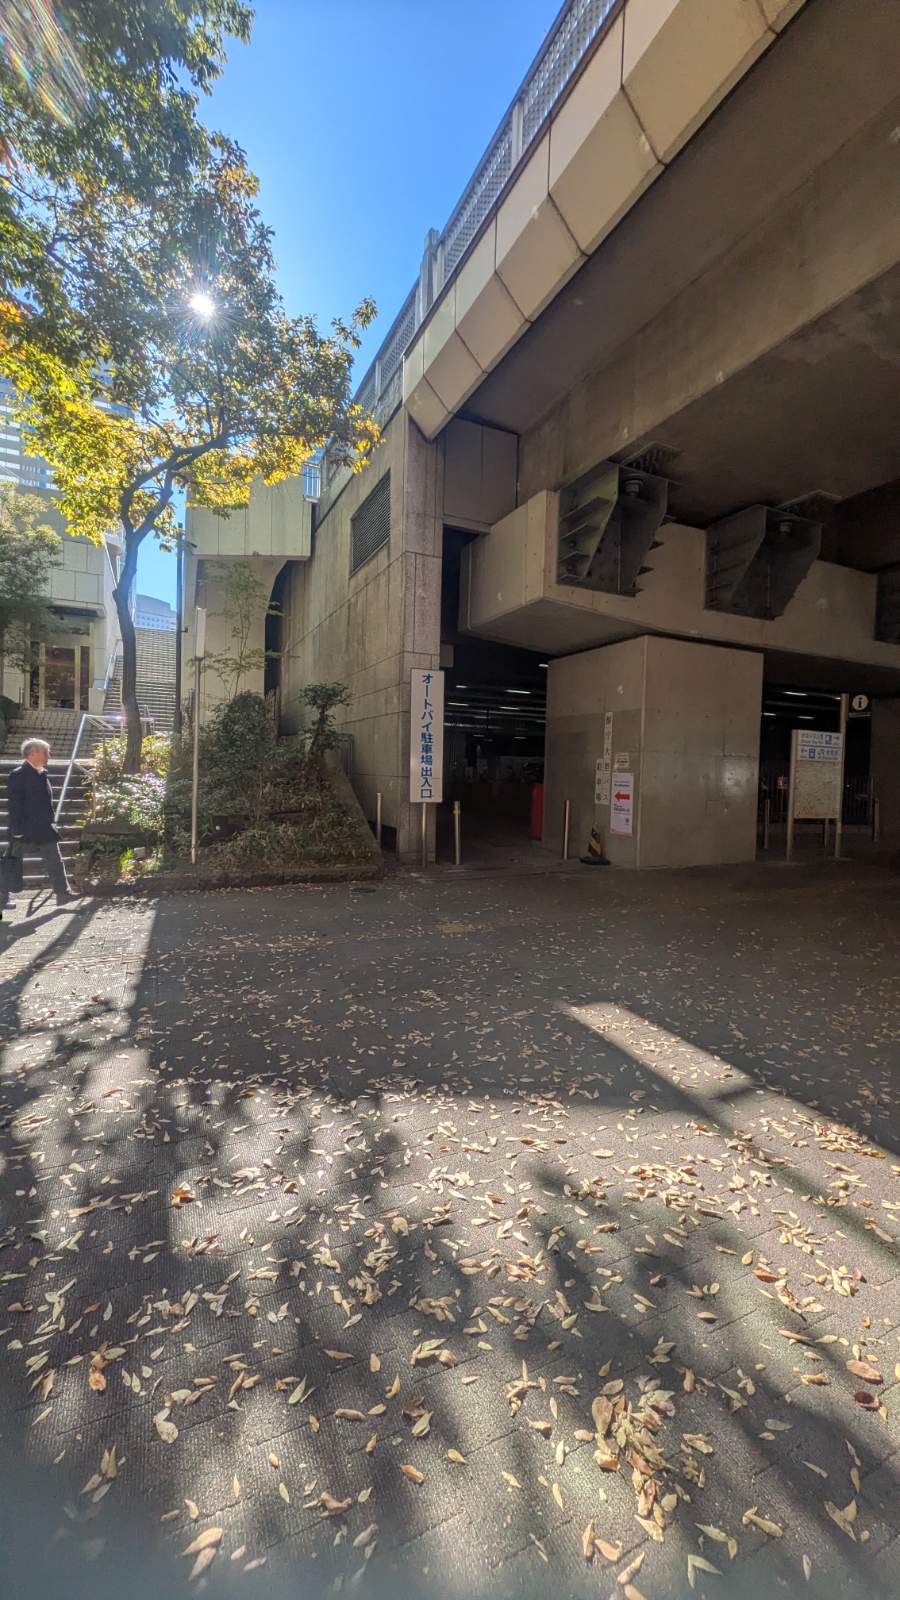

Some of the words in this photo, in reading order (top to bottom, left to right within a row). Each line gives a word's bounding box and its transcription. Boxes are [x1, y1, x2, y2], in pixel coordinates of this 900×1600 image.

[421, 673, 434, 799] オートバイ駐車場出入口
